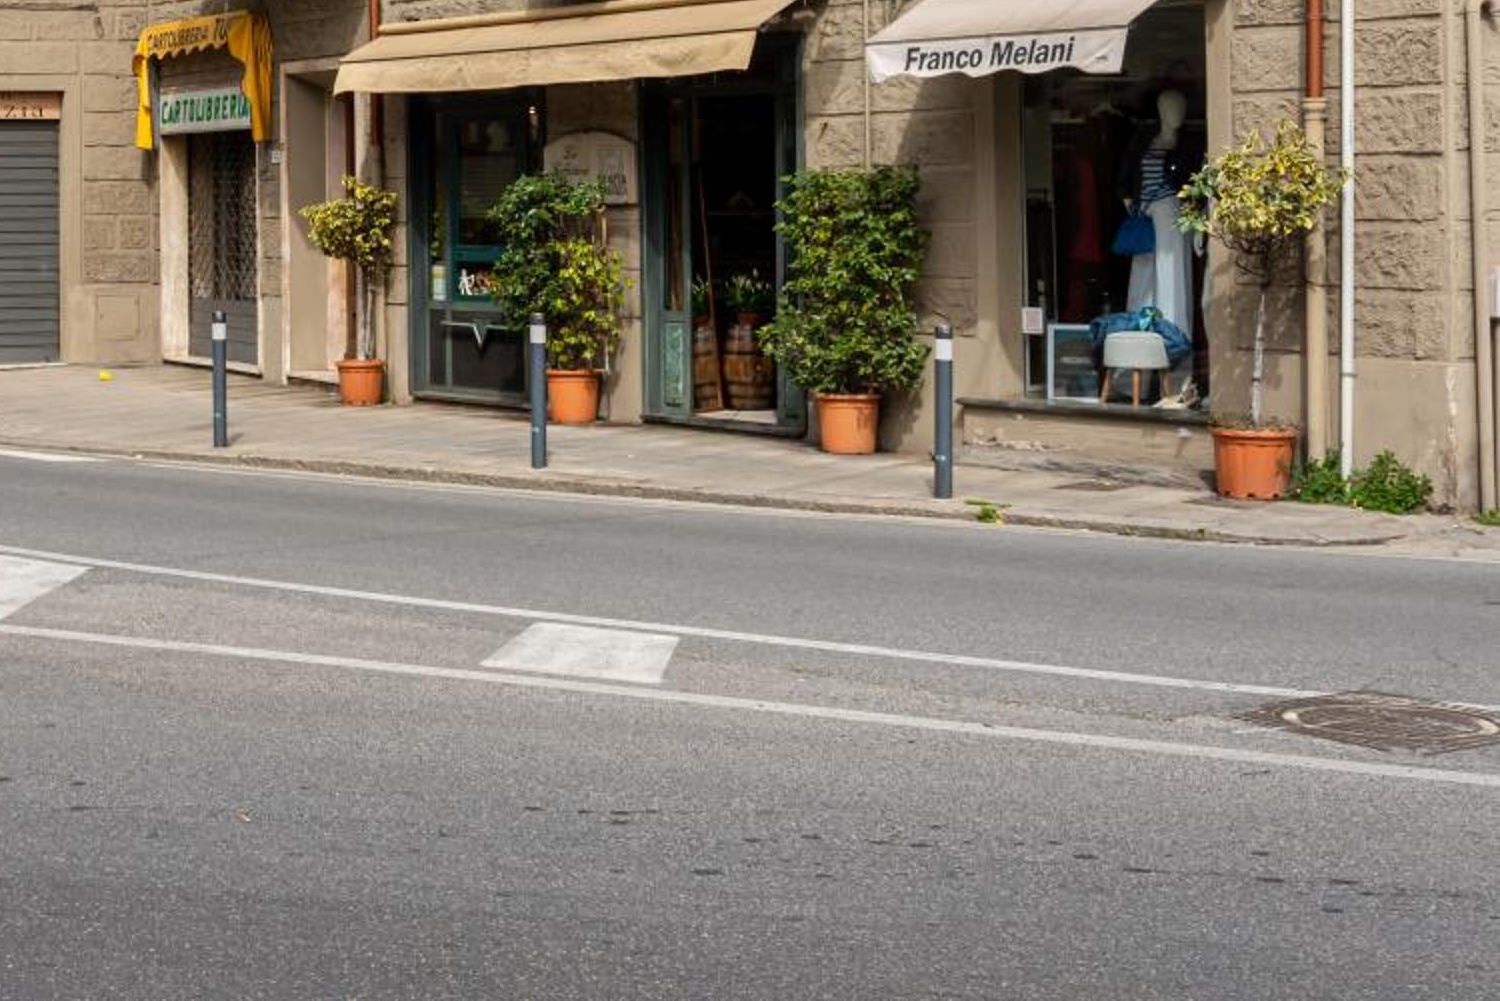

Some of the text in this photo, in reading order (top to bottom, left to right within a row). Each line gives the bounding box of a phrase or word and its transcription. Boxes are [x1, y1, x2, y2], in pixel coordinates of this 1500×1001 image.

[148, 24, 209, 48] CARTOLIBRERIA
[904, 36, 1075, 72] Franco Melani
[161, 94, 250, 125] CARTOLIBRERIA
